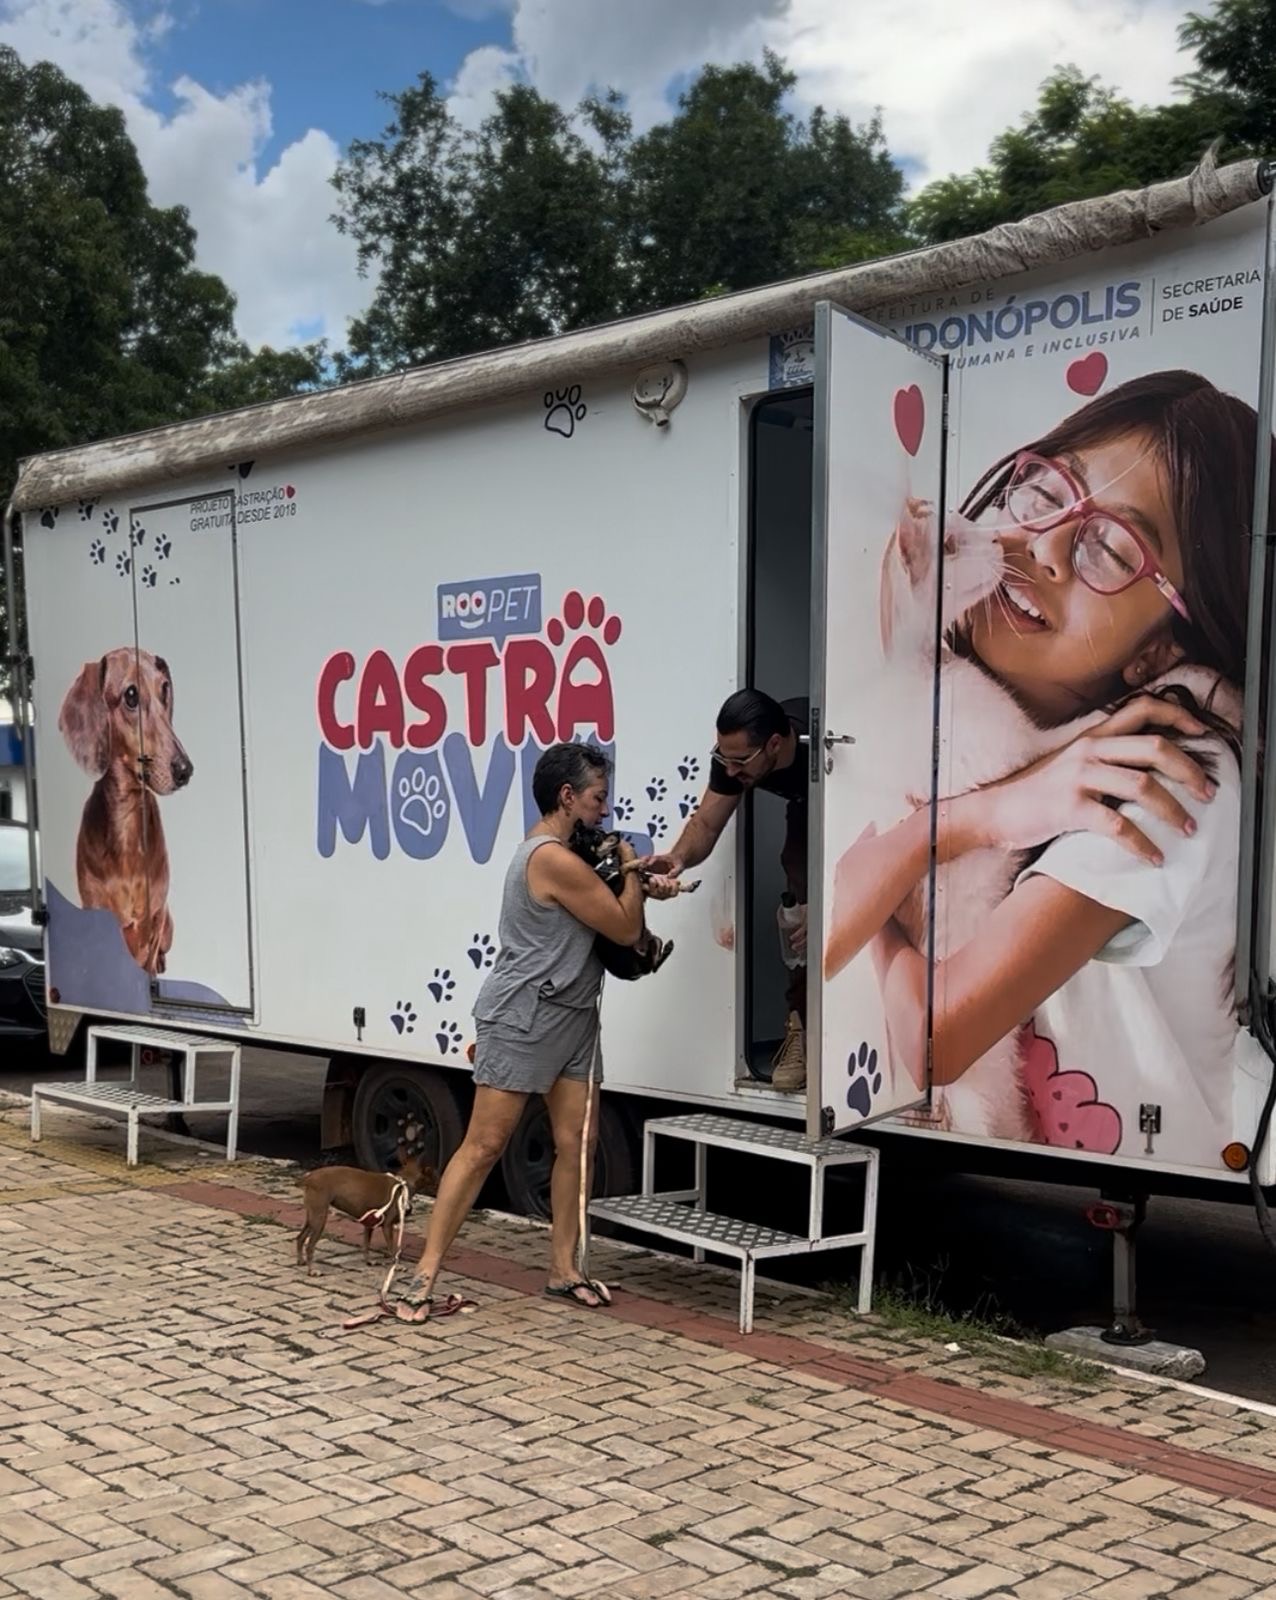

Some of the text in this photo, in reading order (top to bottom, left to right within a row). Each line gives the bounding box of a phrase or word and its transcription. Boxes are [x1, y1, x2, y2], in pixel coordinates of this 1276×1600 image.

[971, 287, 994, 304] DE
[1162, 270, 1261, 299] SECRETARIA
[1162, 297, 1243, 322] DE SAÚDE
[1025, 345, 1035, 357] E
[1043, 326, 1140, 354] INCLUSIVA
[190, 497, 230, 514] PROJETO
[237, 507, 271, 524] DESDE
[273, 502, 297, 519] 2018
[318, 635, 615, 750] CASTRA
